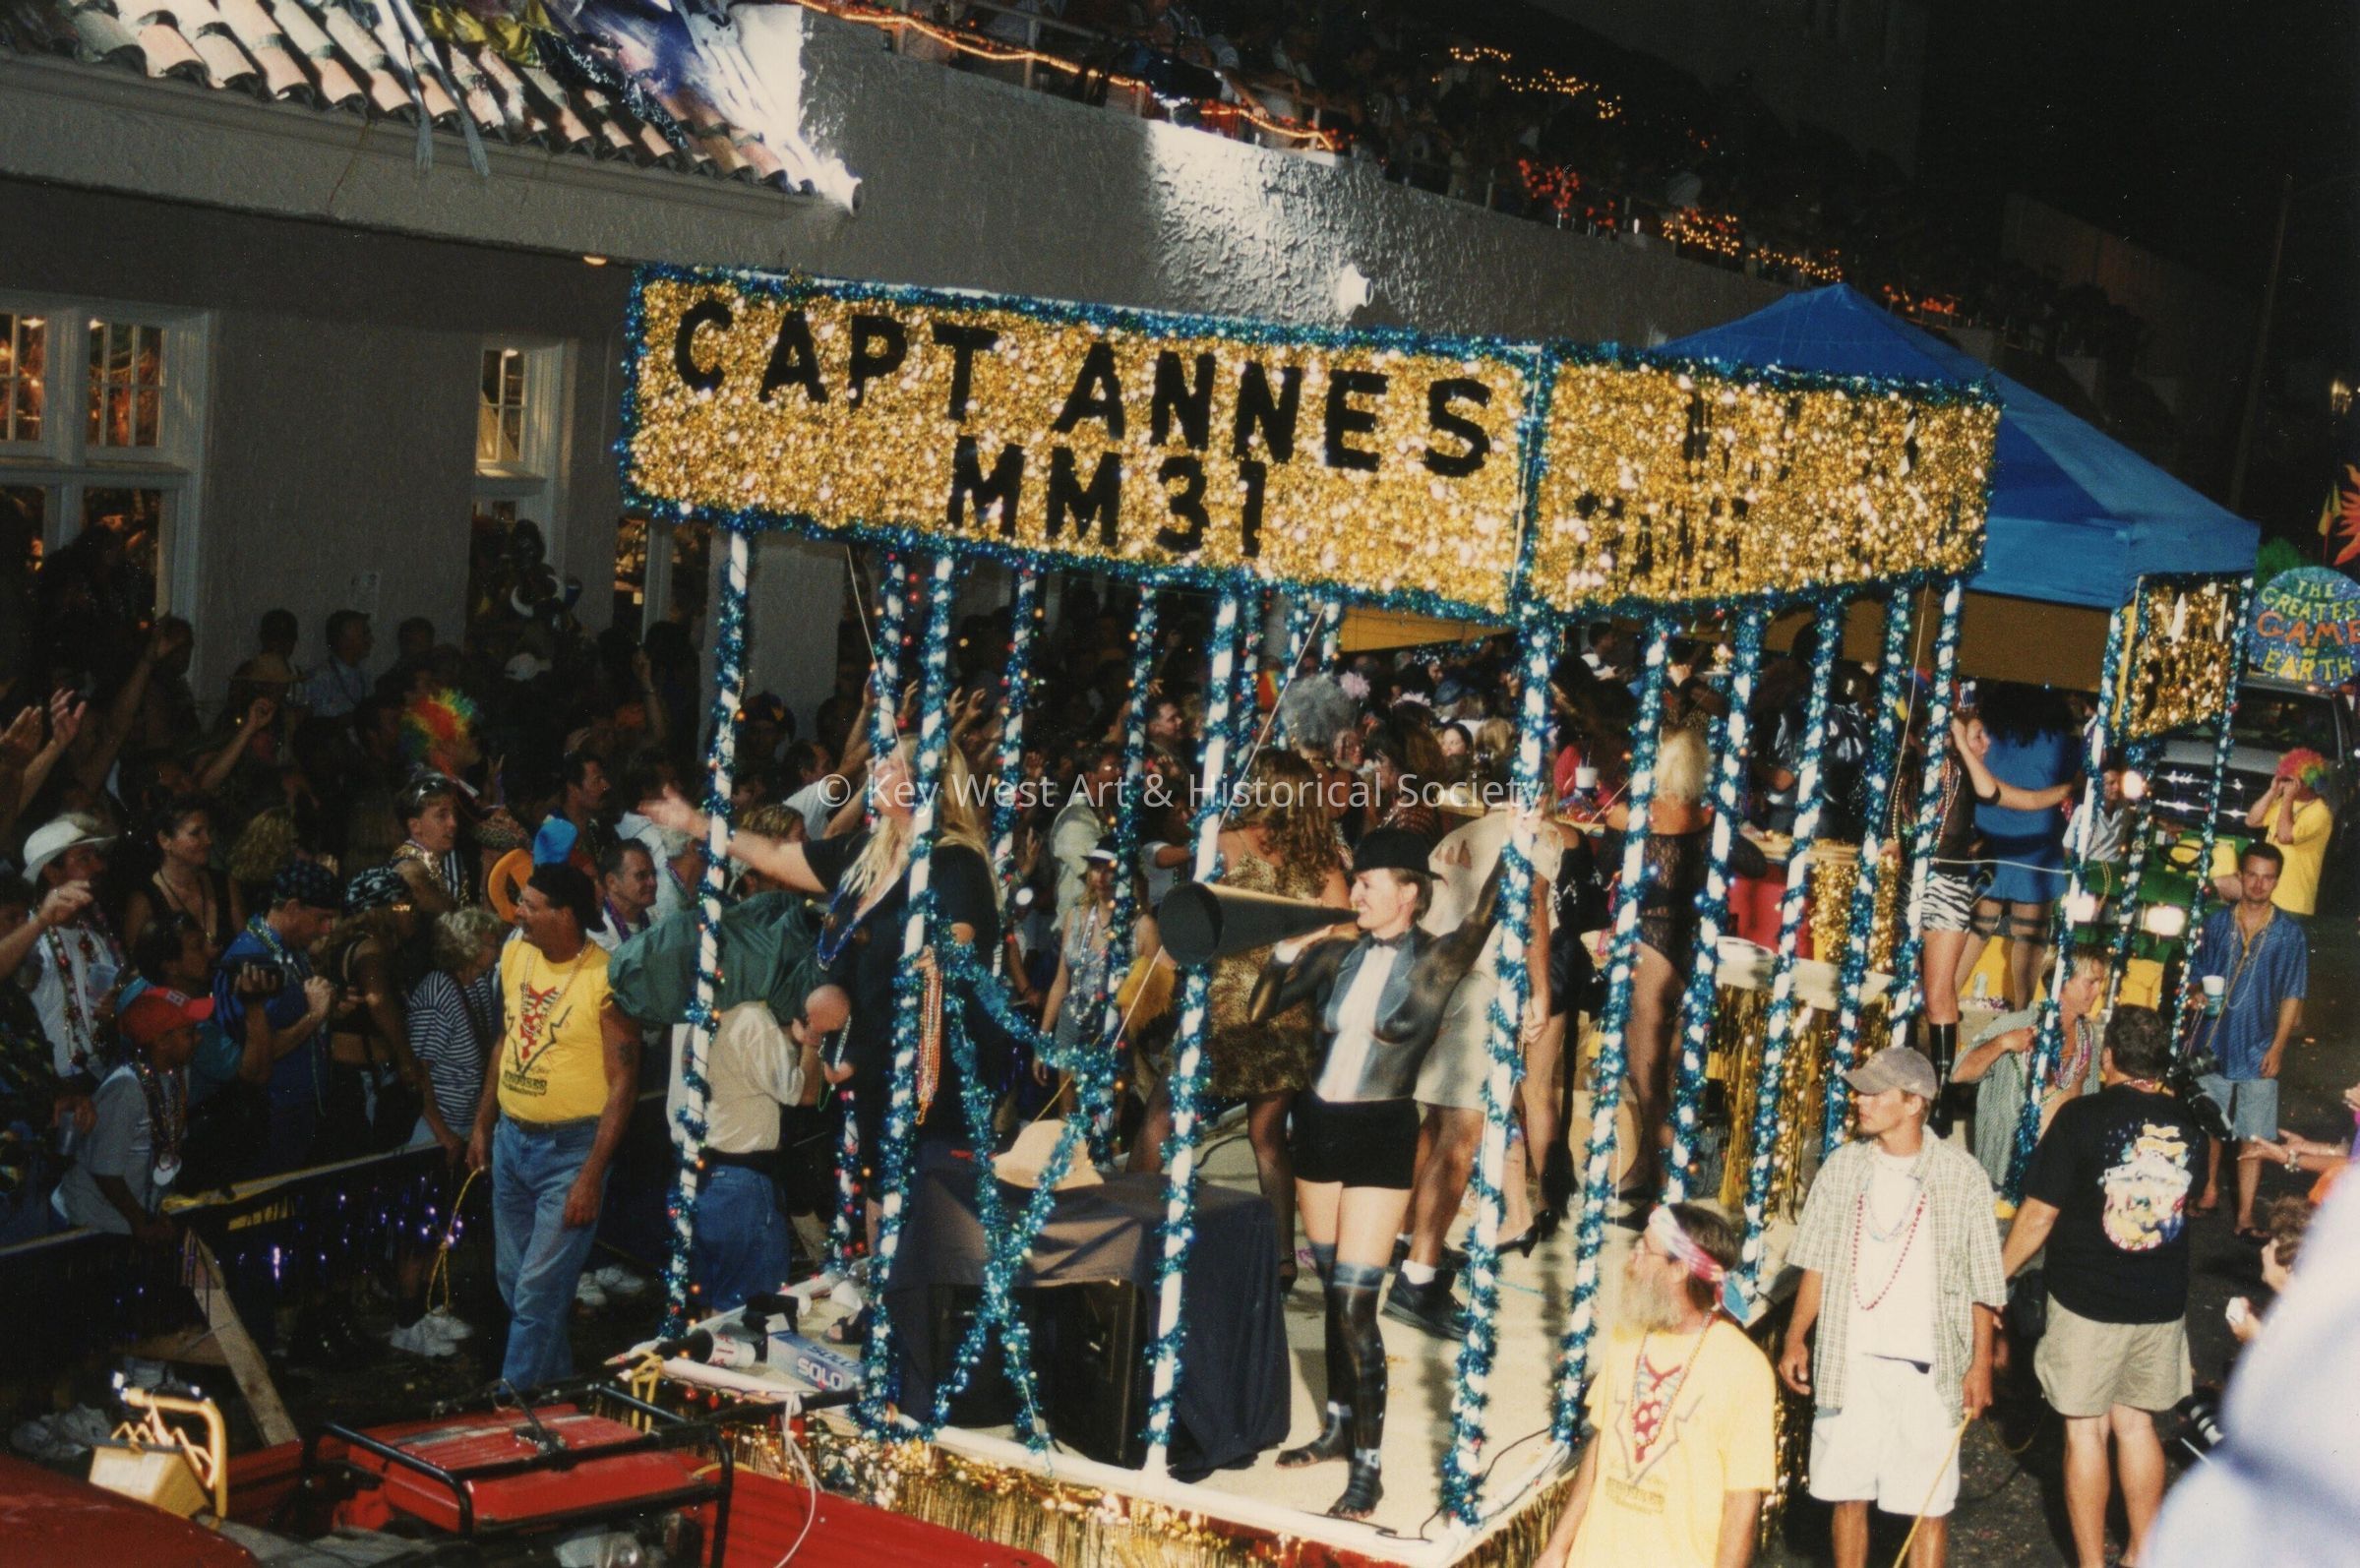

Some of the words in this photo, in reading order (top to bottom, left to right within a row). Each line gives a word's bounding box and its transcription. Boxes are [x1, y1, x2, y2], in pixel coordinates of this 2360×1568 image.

[673, 297, 998, 423] CAPT
[1053, 341, 1492, 477] ANNES
[2262, 586, 2360, 621] GREATES
[2297, 578, 2335, 599] THE
[2263, 649, 2353, 682] EARTH
[798, 1357, 843, 1391] SOLO
